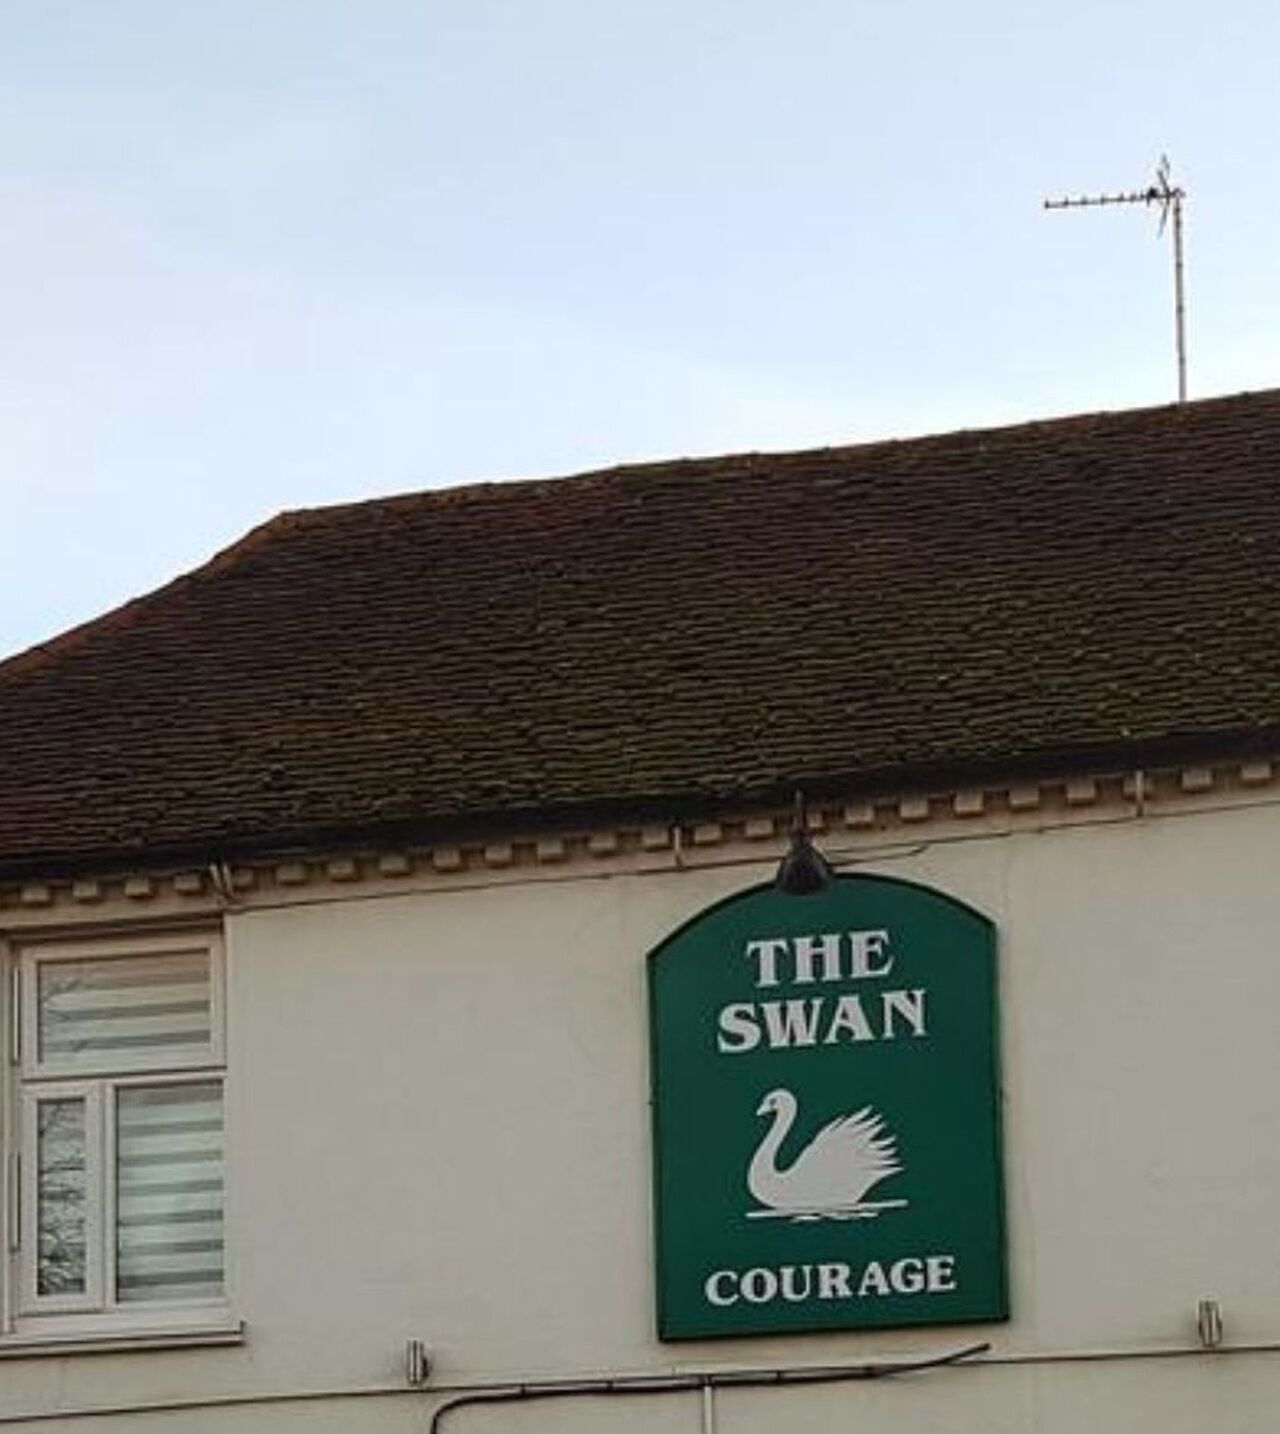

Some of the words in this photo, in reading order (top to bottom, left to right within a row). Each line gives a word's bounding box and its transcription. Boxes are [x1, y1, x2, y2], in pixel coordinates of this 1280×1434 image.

[745, 931, 894, 988] THE
[717, 989, 927, 1053] SWAN
[705, 1255, 957, 1306] COURAGE
